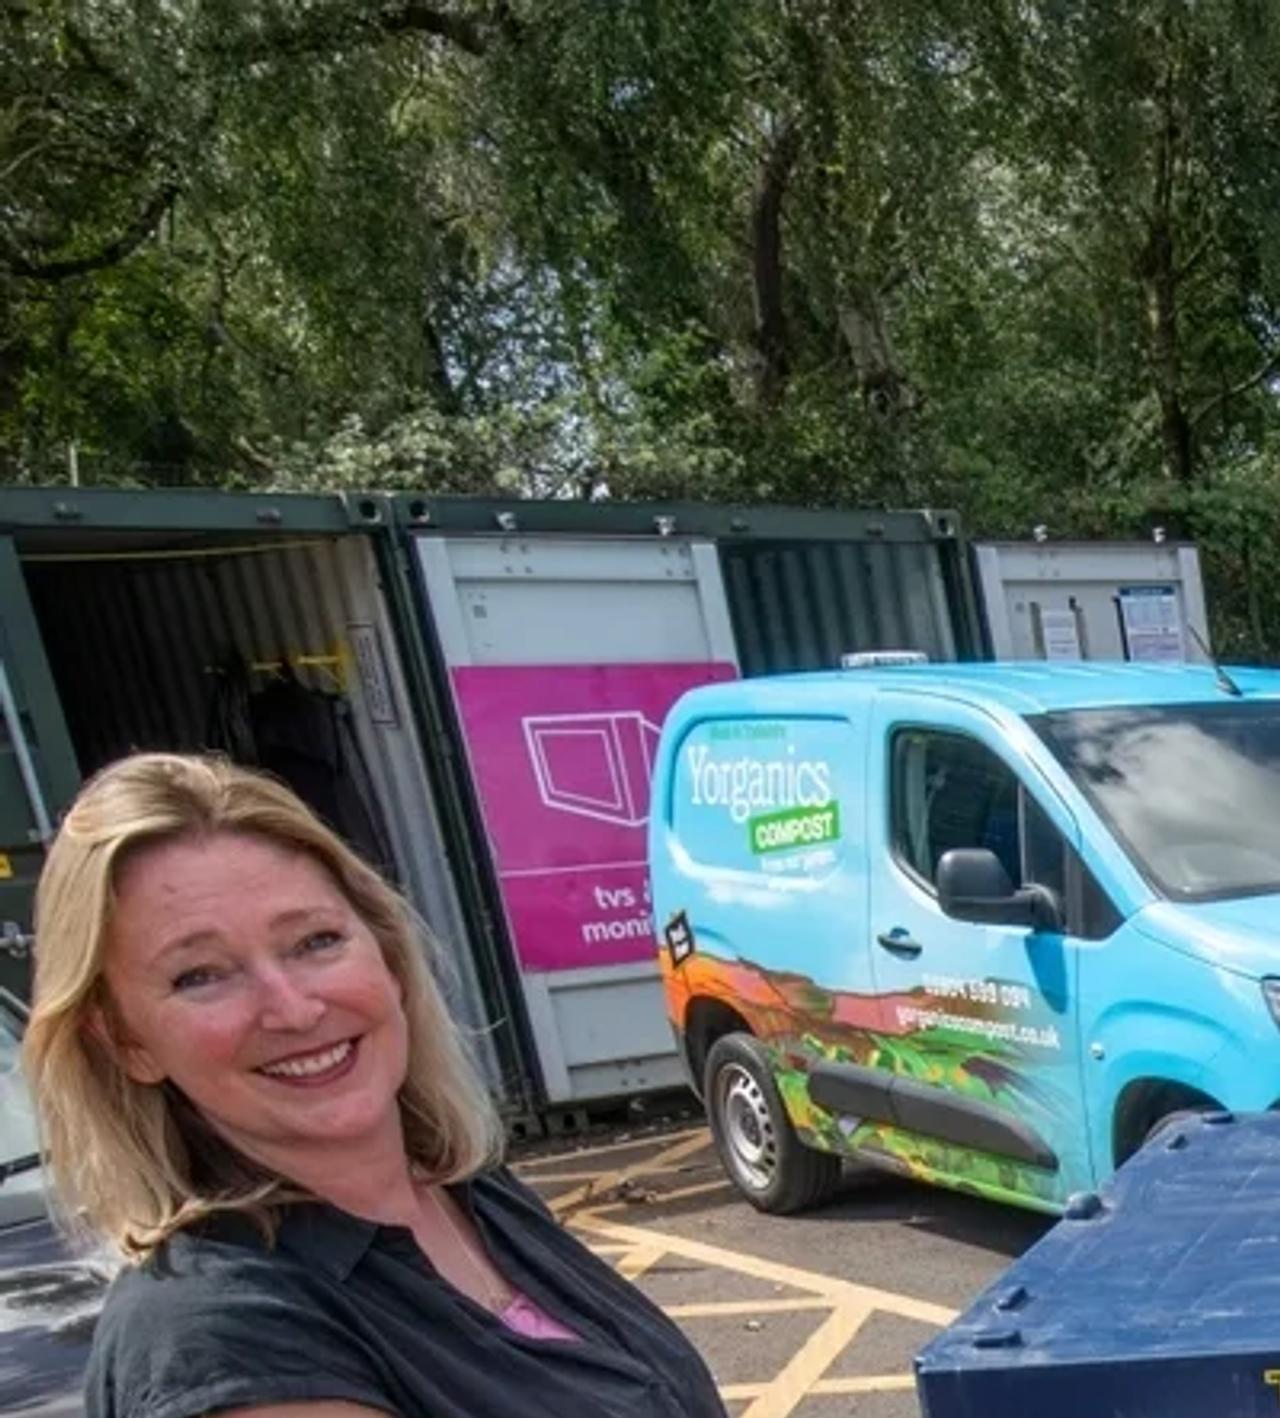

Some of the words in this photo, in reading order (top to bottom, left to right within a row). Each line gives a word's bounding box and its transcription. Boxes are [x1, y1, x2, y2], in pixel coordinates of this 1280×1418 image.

[687, 743, 833, 824] Yorganics
[754, 812, 834, 849] COMPOST
[594, 886, 636, 910] tvs
[582, 908, 652, 942] moni
